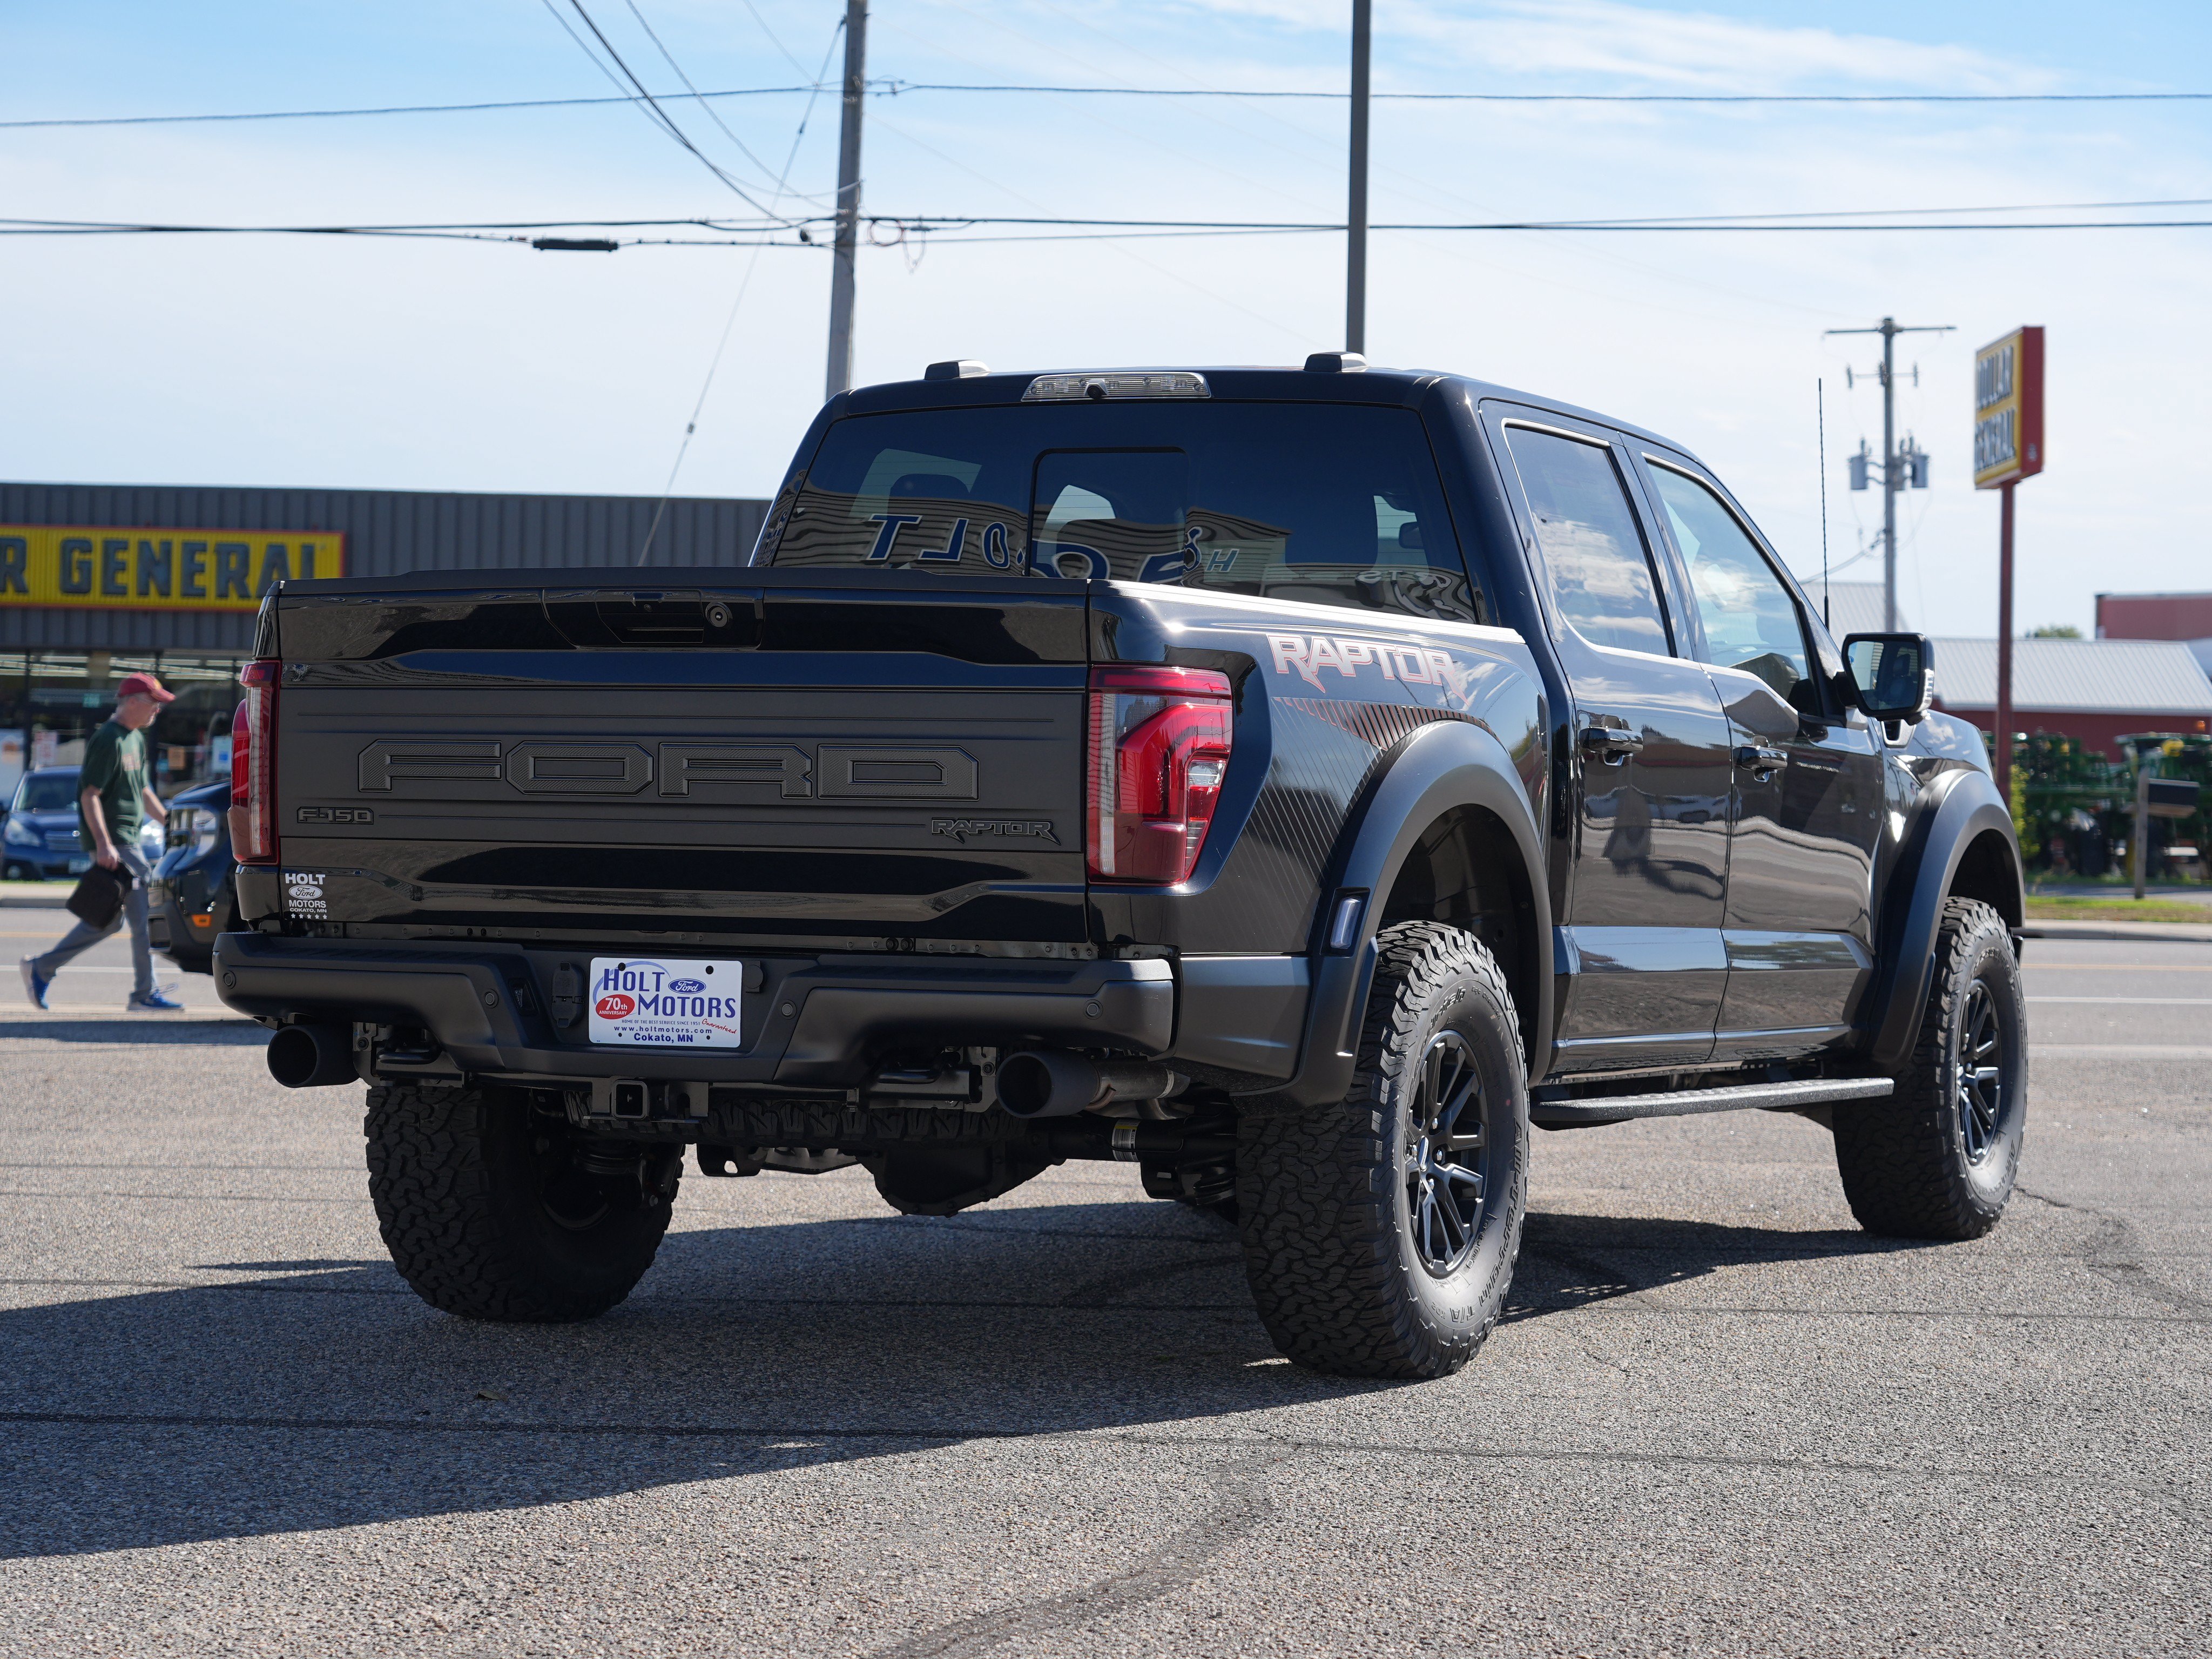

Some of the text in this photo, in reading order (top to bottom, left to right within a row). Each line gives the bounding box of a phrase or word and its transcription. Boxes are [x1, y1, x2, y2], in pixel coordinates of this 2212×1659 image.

[1266, 633, 1469, 706] RAPTOR
[358, 739, 980, 801] FORD
[298, 807, 374, 825] F-150
[932, 817, 1062, 846] RAPTOR
[285, 873, 326, 885] HOLT
[295, 886, 316, 898] Ford
[288, 899, 327, 908] MOTORS
[603, 968, 665, 992] HOLT
[675, 980, 699, 992] Ford
[605, 997, 628, 1010] 70th
[638, 993, 736, 1019] MOTORS
[702, 1019, 737, 1034] Guaranteed
[633, 1033, 693, 1043] Cokato, MN
